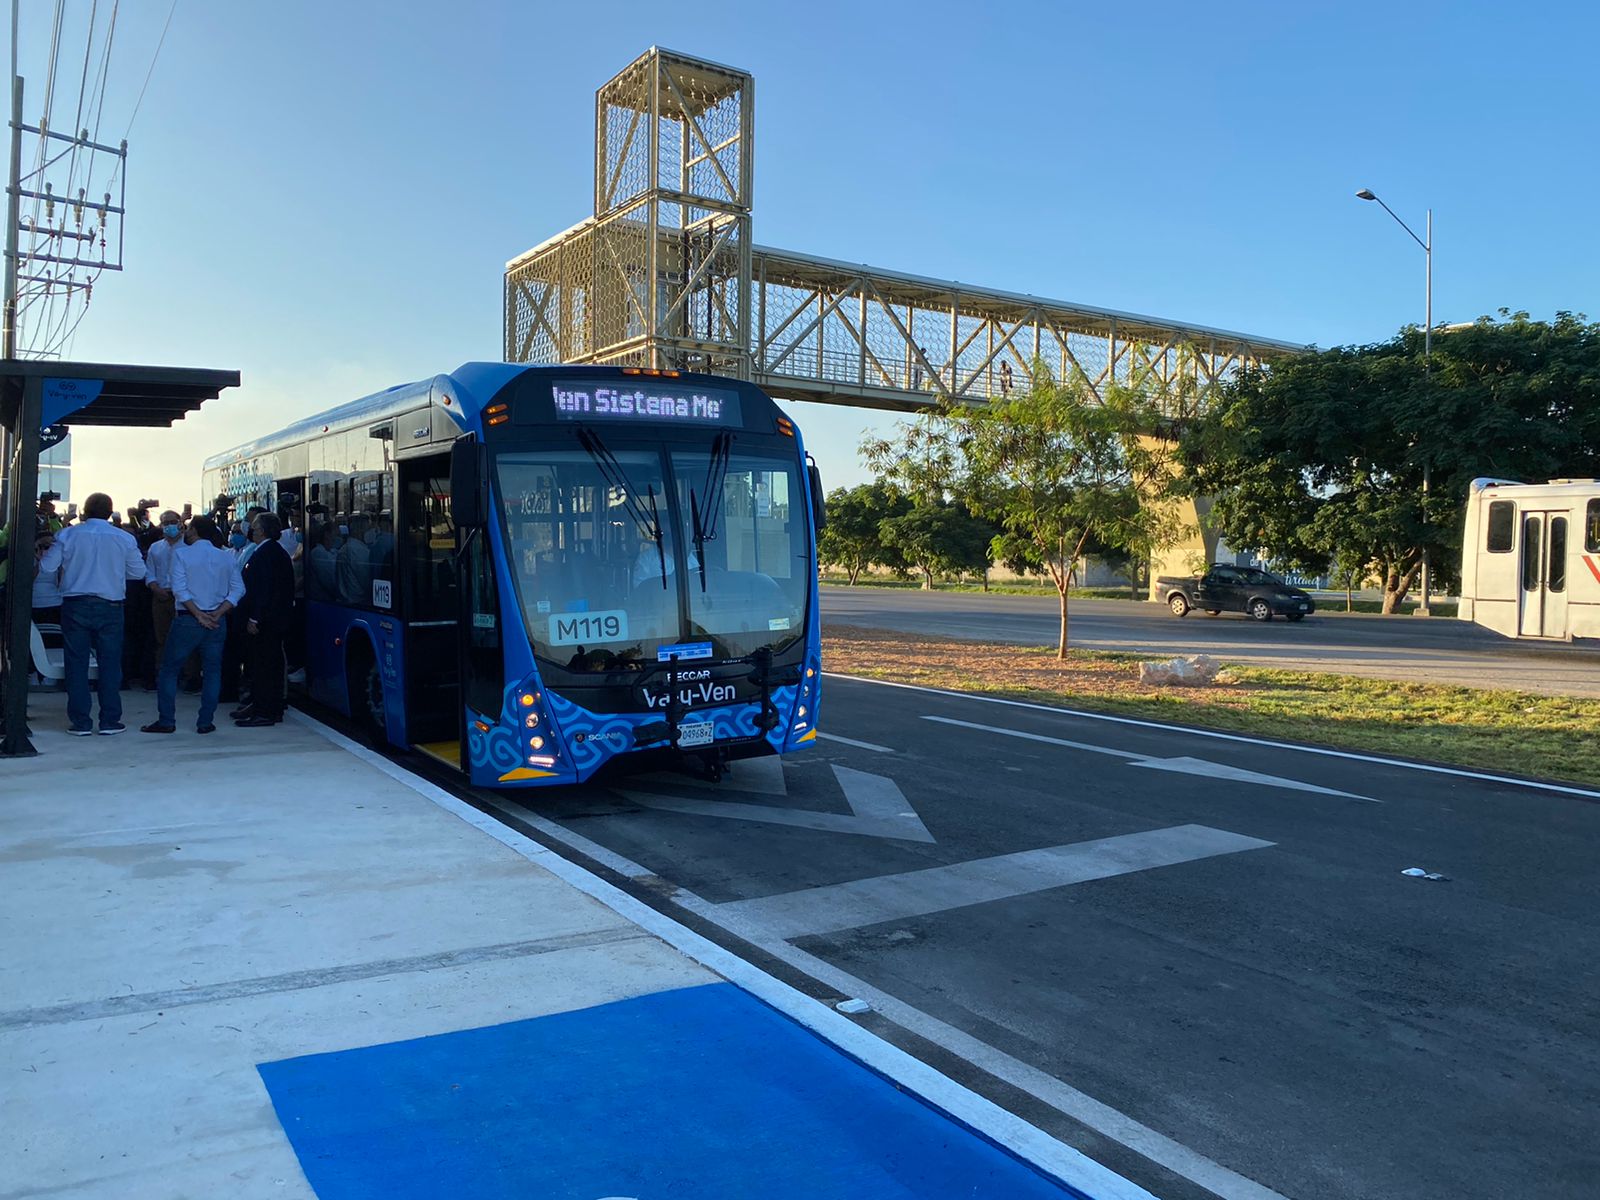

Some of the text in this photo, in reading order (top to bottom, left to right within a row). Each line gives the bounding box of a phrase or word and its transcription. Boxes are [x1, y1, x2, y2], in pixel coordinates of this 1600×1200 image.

[595, 388, 688, 416] Sistema
[692, 394, 723, 418] Me
[374, 584, 390, 604] M119
[557, 616, 620, 641] M119
